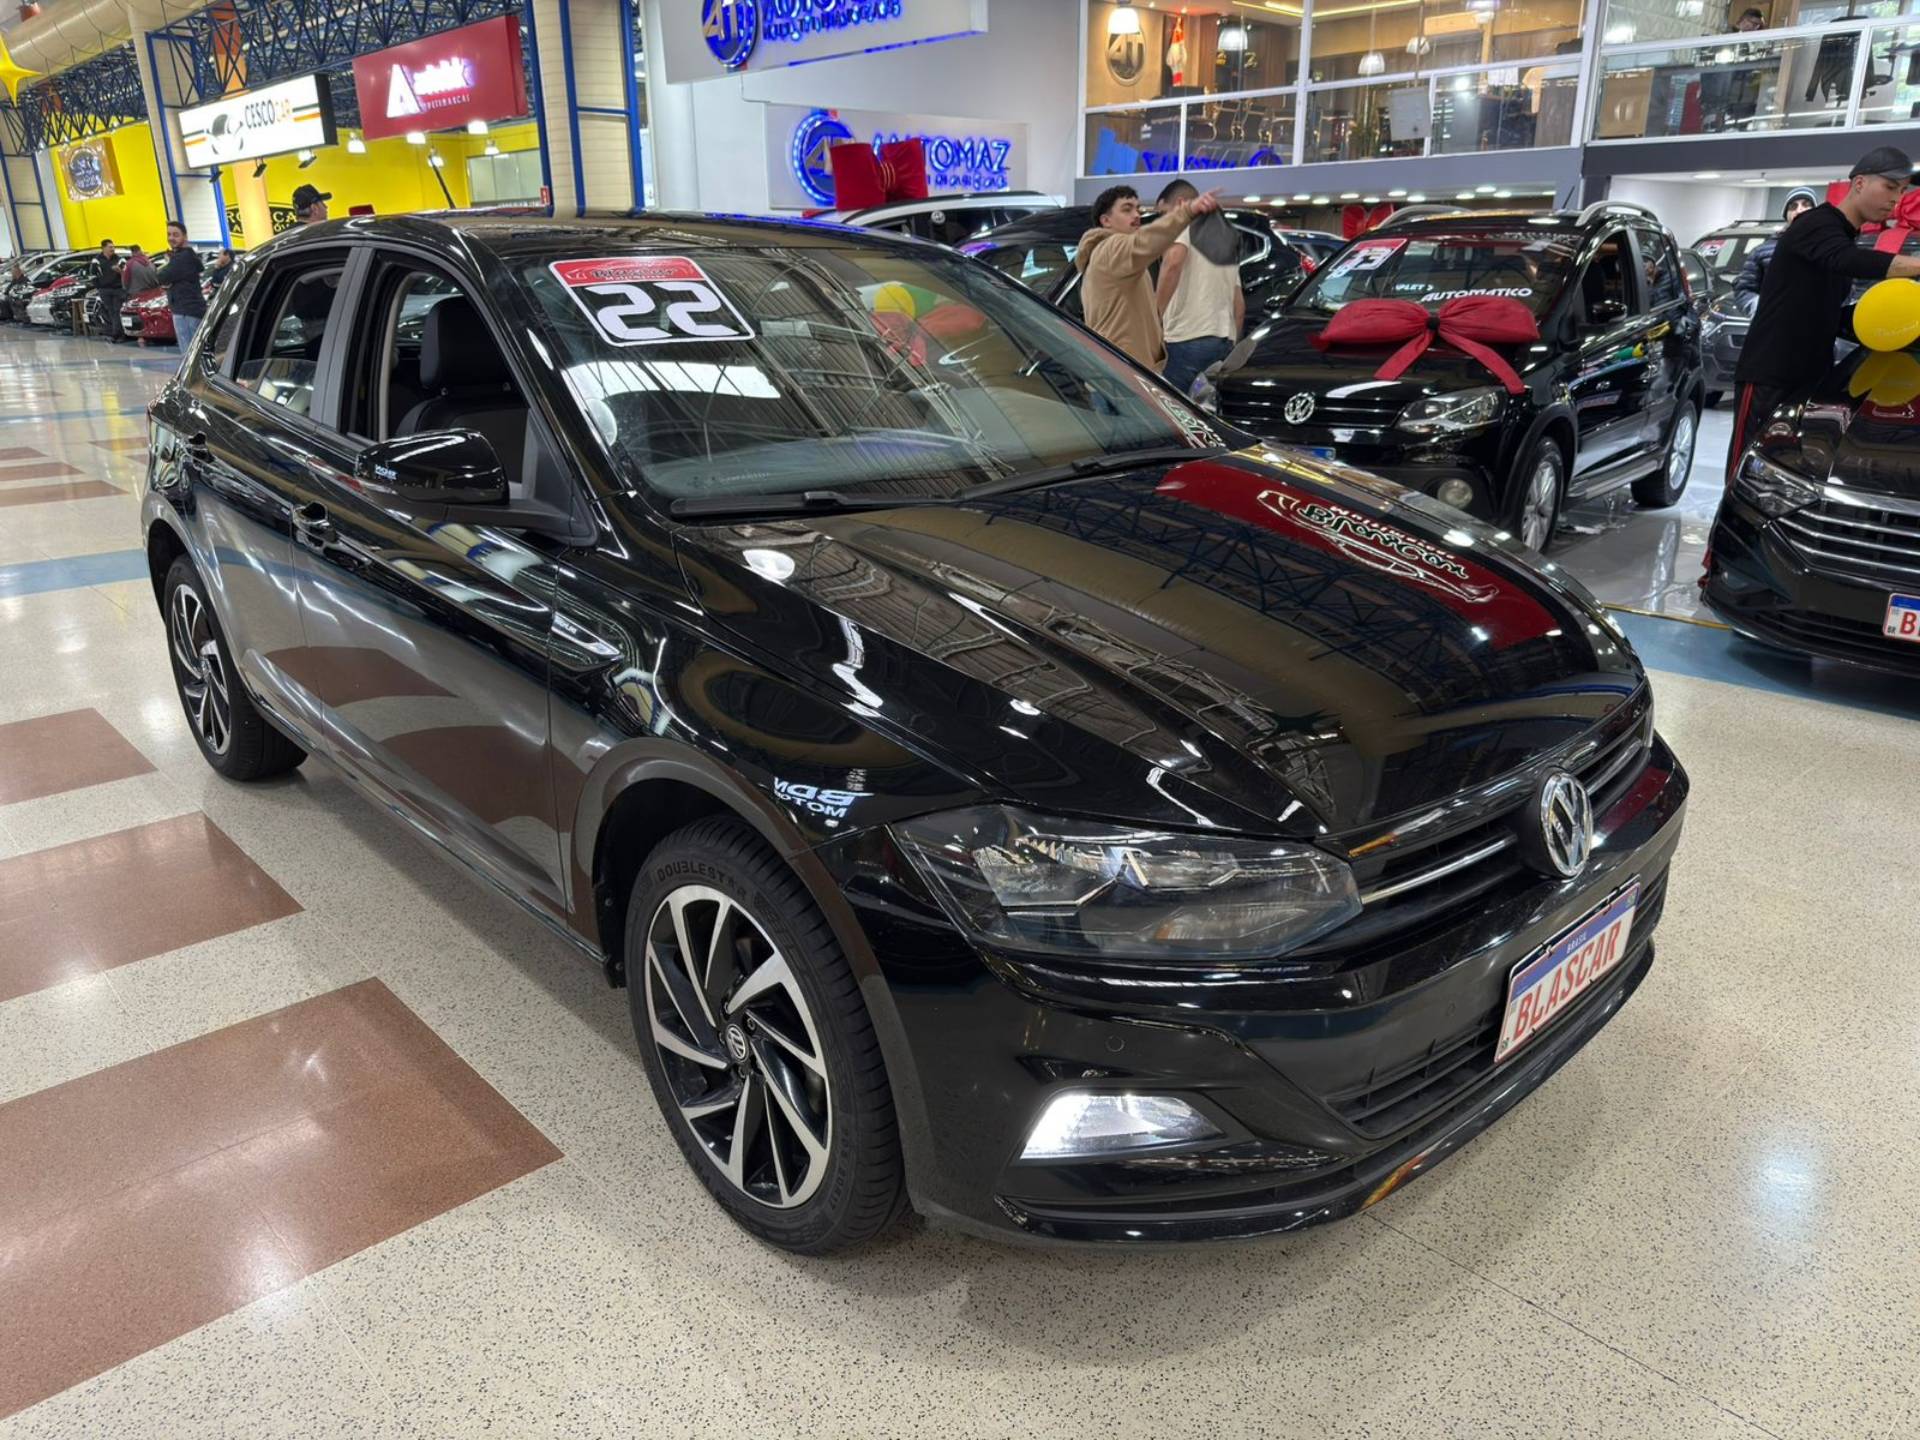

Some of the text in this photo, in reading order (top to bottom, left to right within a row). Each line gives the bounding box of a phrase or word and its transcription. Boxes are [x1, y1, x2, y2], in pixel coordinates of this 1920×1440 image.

[585, 281, 740, 340] 22
[1900, 611, 1920, 635] B
[656, 860, 747, 899] DOUBLESTAR
[1513, 920, 1622, 1041] BLASCAR
